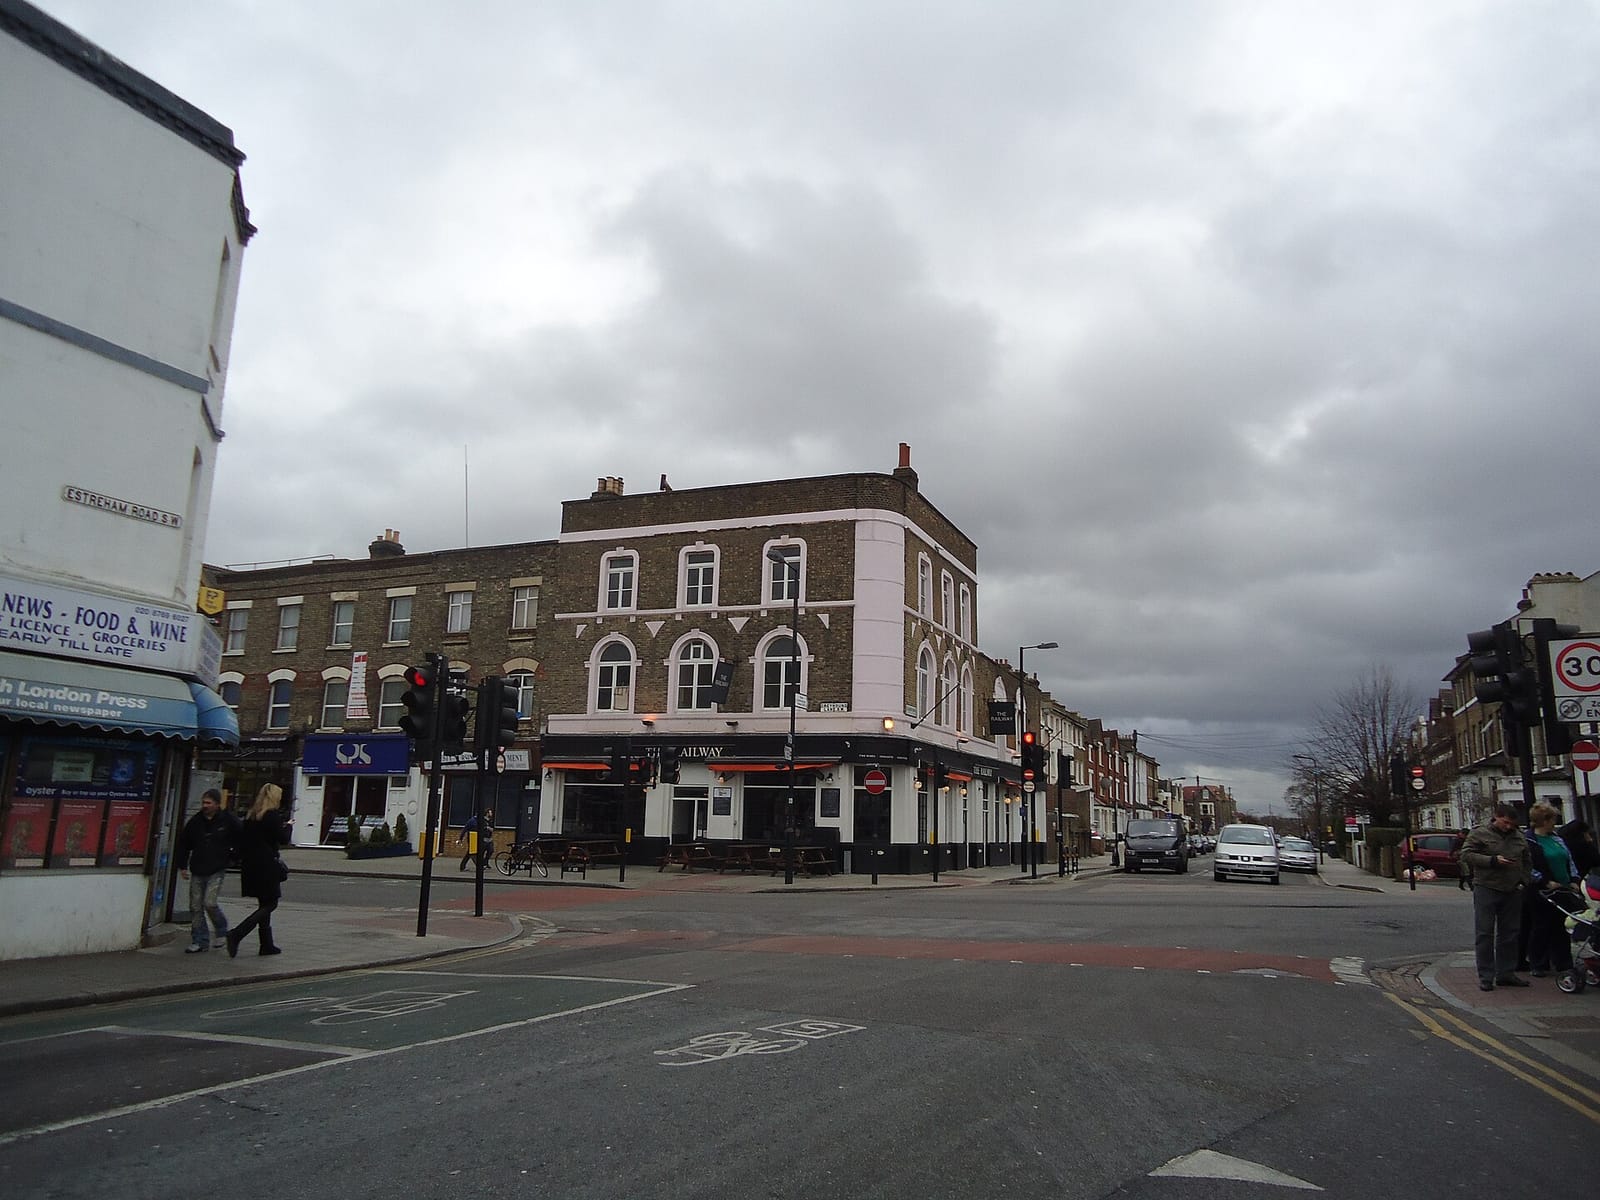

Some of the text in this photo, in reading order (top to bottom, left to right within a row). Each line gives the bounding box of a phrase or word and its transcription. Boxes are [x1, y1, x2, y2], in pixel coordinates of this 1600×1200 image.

[67, 488, 127, 513] ESTREHAM
[131, 506, 159, 521] ROAD
[2, 592, 53, 620] NEWS
[75, 606, 120, 631] FOOD
[127, 616, 140, 635] &
[149, 620, 188, 644] WINE
[0, 628, 134, 658] EARLY TILL LATE
[10, 616, 71, 637] LICENCE
[92, 631, 167, 652] GROCERIES
[1564, 654, 1600, 677] 30
[16, 697, 49, 711] local
[53, 703, 123, 718] newspaper
[18, 680, 92, 704] London
[96, 690, 149, 710] Press
[678, 747, 724, 758] AILWAY
[25, 786, 57, 797] oyster
